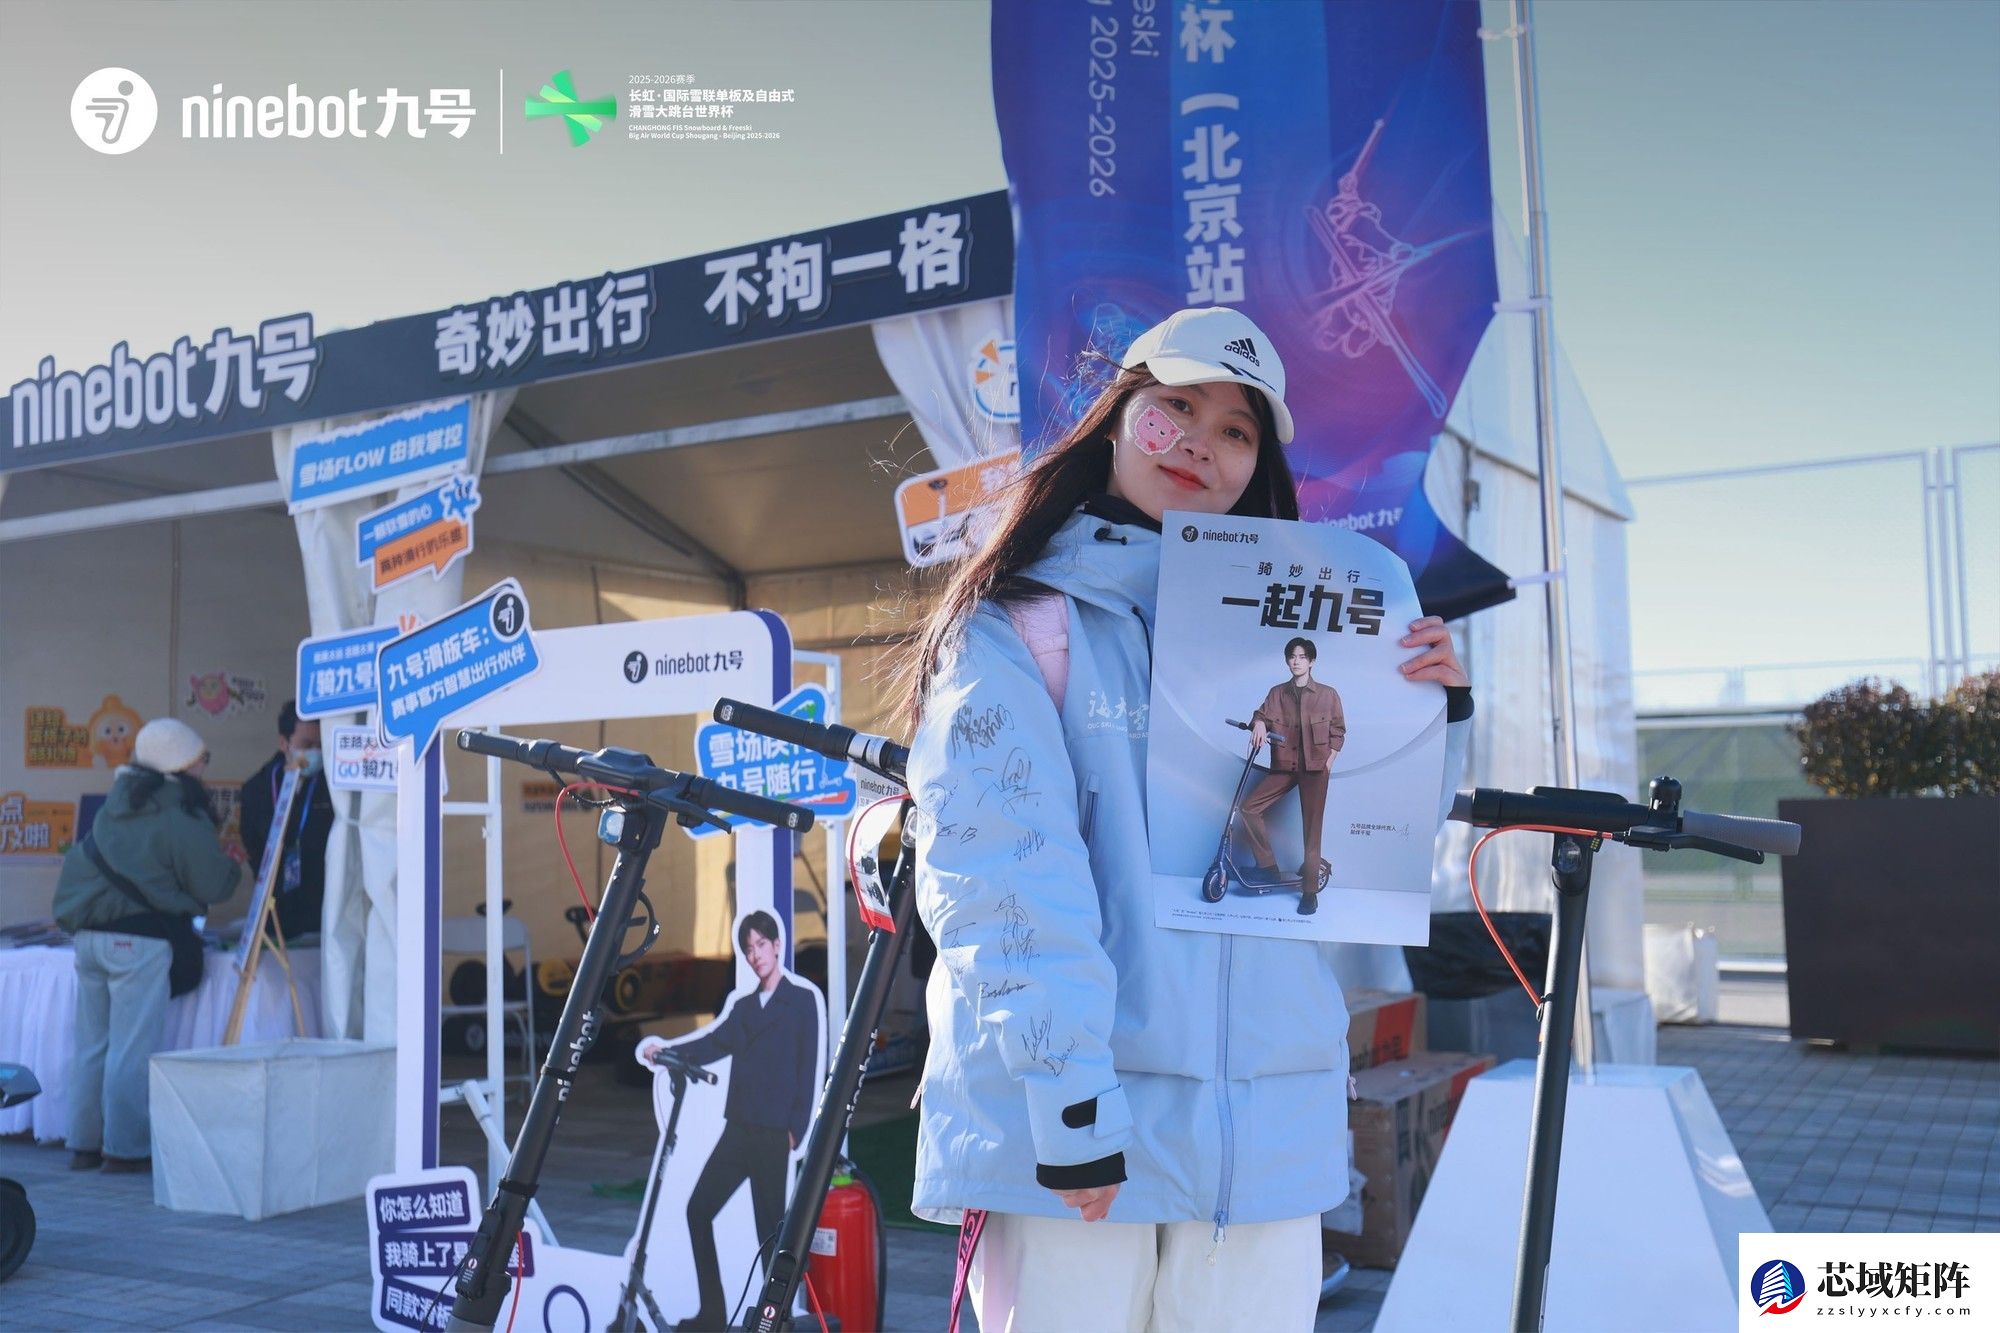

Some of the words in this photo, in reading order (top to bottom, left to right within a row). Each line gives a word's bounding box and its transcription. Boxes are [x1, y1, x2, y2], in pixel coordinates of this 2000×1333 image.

[1087, 16, 1120, 198] 2025-2026
[1180, 0, 1245, 305] 杯（北京站
[434, 273, 649, 375] 奇妙出行
[703, 211, 964, 326] 不拘一格
[1224, 344, 1260, 367] adidas
[389, 423, 464, 465] 由我掌控
[1257, 561, 1360, 583] 骑妙出行
[1221, 583, 1385, 635] 一起九号
[316, 660, 377, 697] 骑九号
[390, 645, 526, 720] 赛事官方智慧出行伙伴
[361, 759, 398, 779] 骑九
[709, 729, 812, 769] 雪场快
[379, 1190, 464, 1223] 你怎么知道
